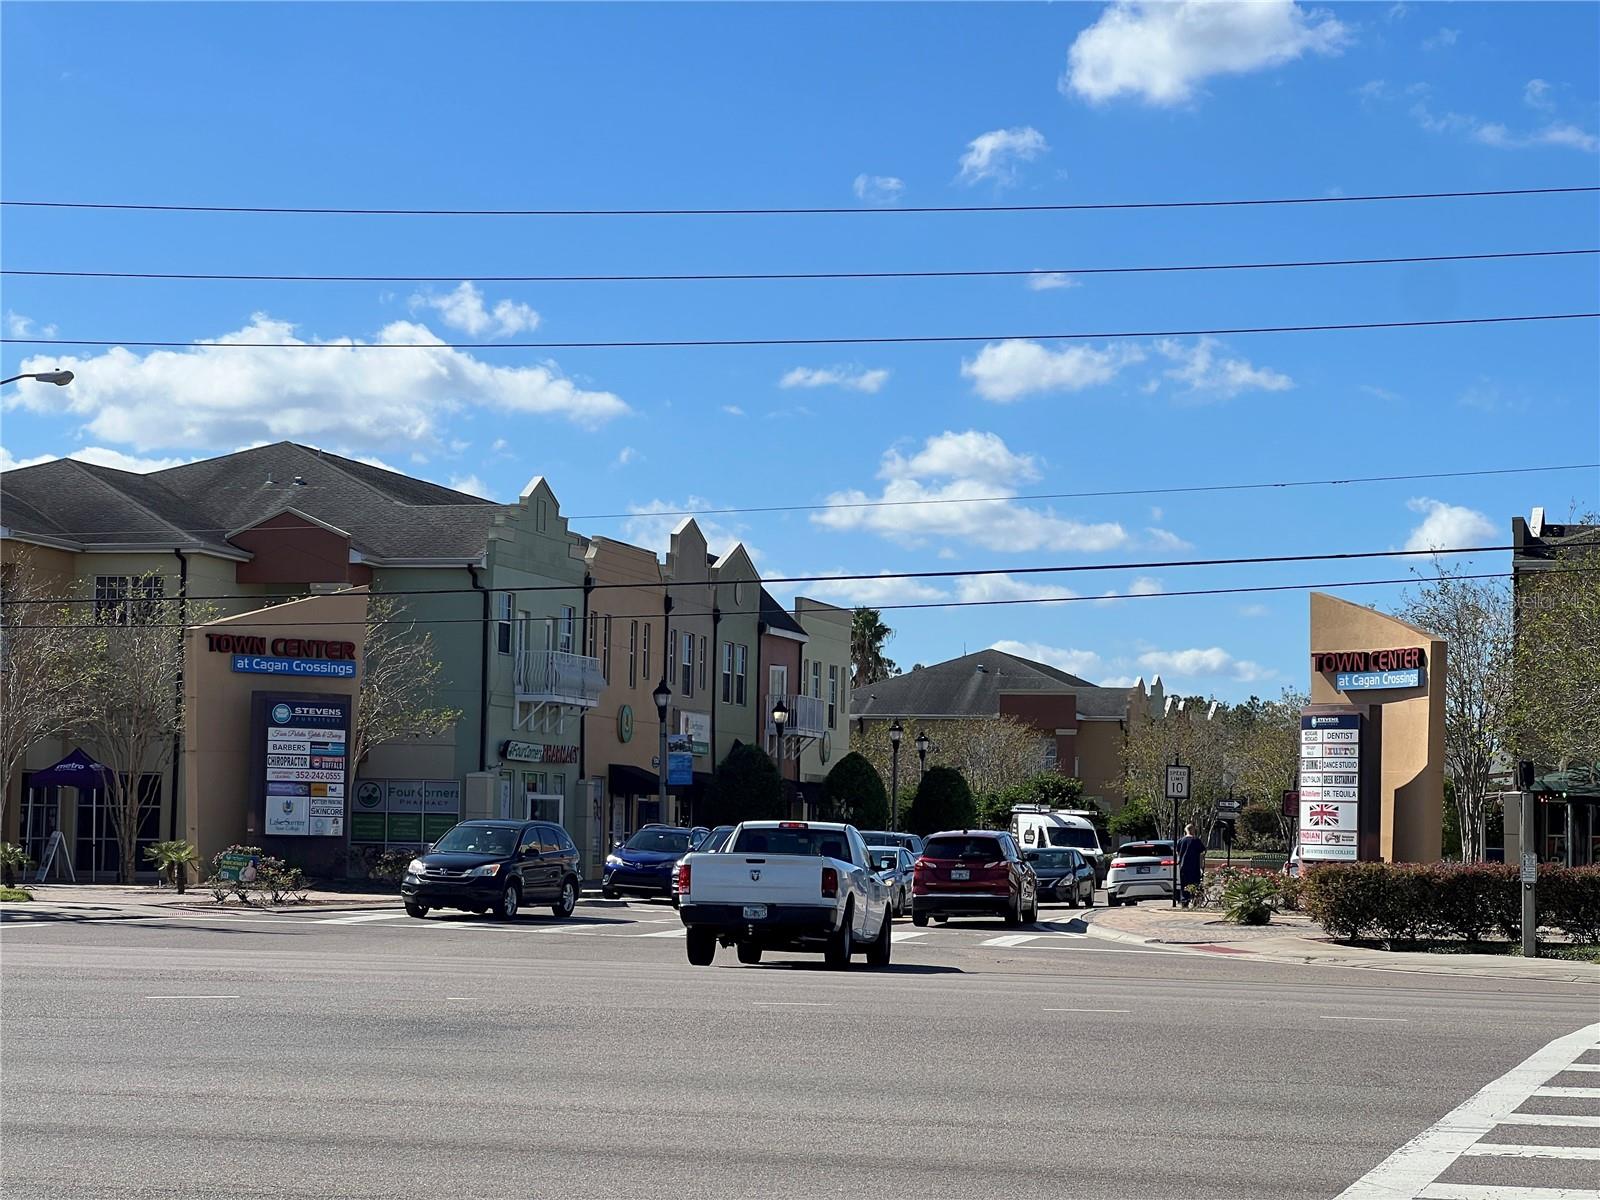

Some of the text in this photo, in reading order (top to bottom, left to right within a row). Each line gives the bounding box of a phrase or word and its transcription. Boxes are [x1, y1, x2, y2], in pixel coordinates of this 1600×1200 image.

[205, 633, 356, 660] TOWN CENTER
[1311, 648, 1420, 672] TOWN CENTER
[236, 658, 353, 676] at Cagan Crossings
[1338, 671, 1418, 688] at Cagan Crossings
[294, 707, 342, 716] STEVENS
[1326, 732, 1353, 740] DENTIST
[272, 743, 306, 752] BARBERS
[56, 762, 85, 770] metro
[267, 755, 308, 768] CHIROPRACTOR
[1339, 761, 1358, 769] STUDIO
[295, 771, 341, 780] 352-242-0555
[1172, 782, 1183, 793] 10
[387, 787, 459, 799] Four Corners
[1333, 790, 1357, 798] TEQUILA
[310, 808, 343, 816] SKINCORE
